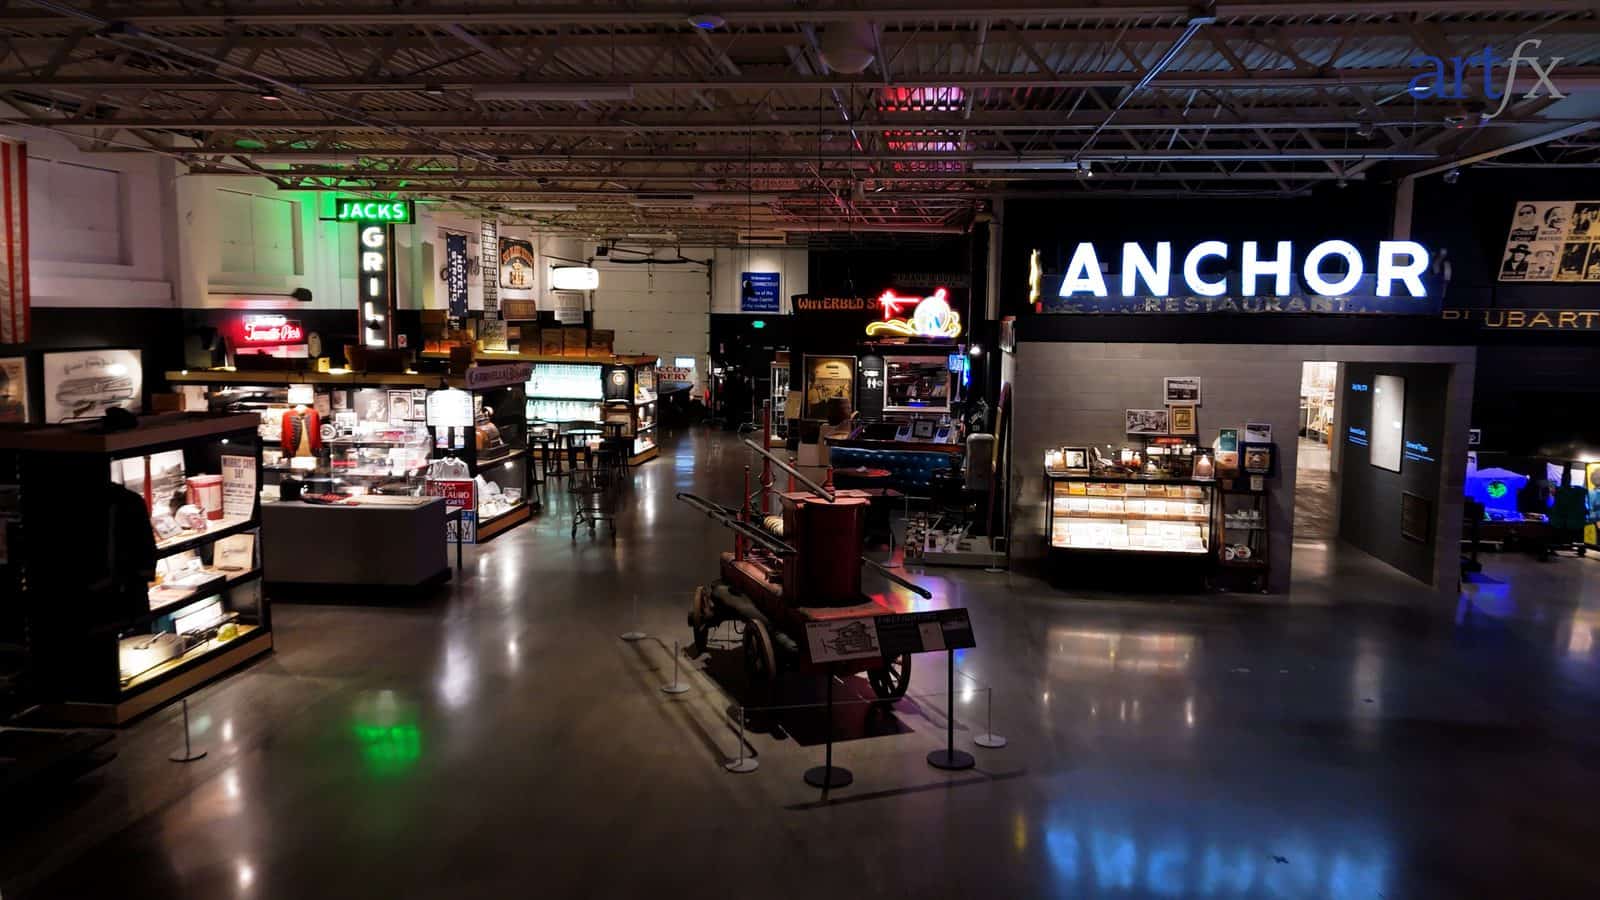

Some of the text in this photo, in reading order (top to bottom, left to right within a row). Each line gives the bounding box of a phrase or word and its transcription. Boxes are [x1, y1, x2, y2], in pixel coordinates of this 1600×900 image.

[339, 203, 405, 220] JACKS
[362, 226, 385, 346] GRILL
[456, 254, 464, 298] HOTEL
[1058, 239, 1430, 297] ANCHOR
[1143, 296, 1352, 313] RESTAURANT
